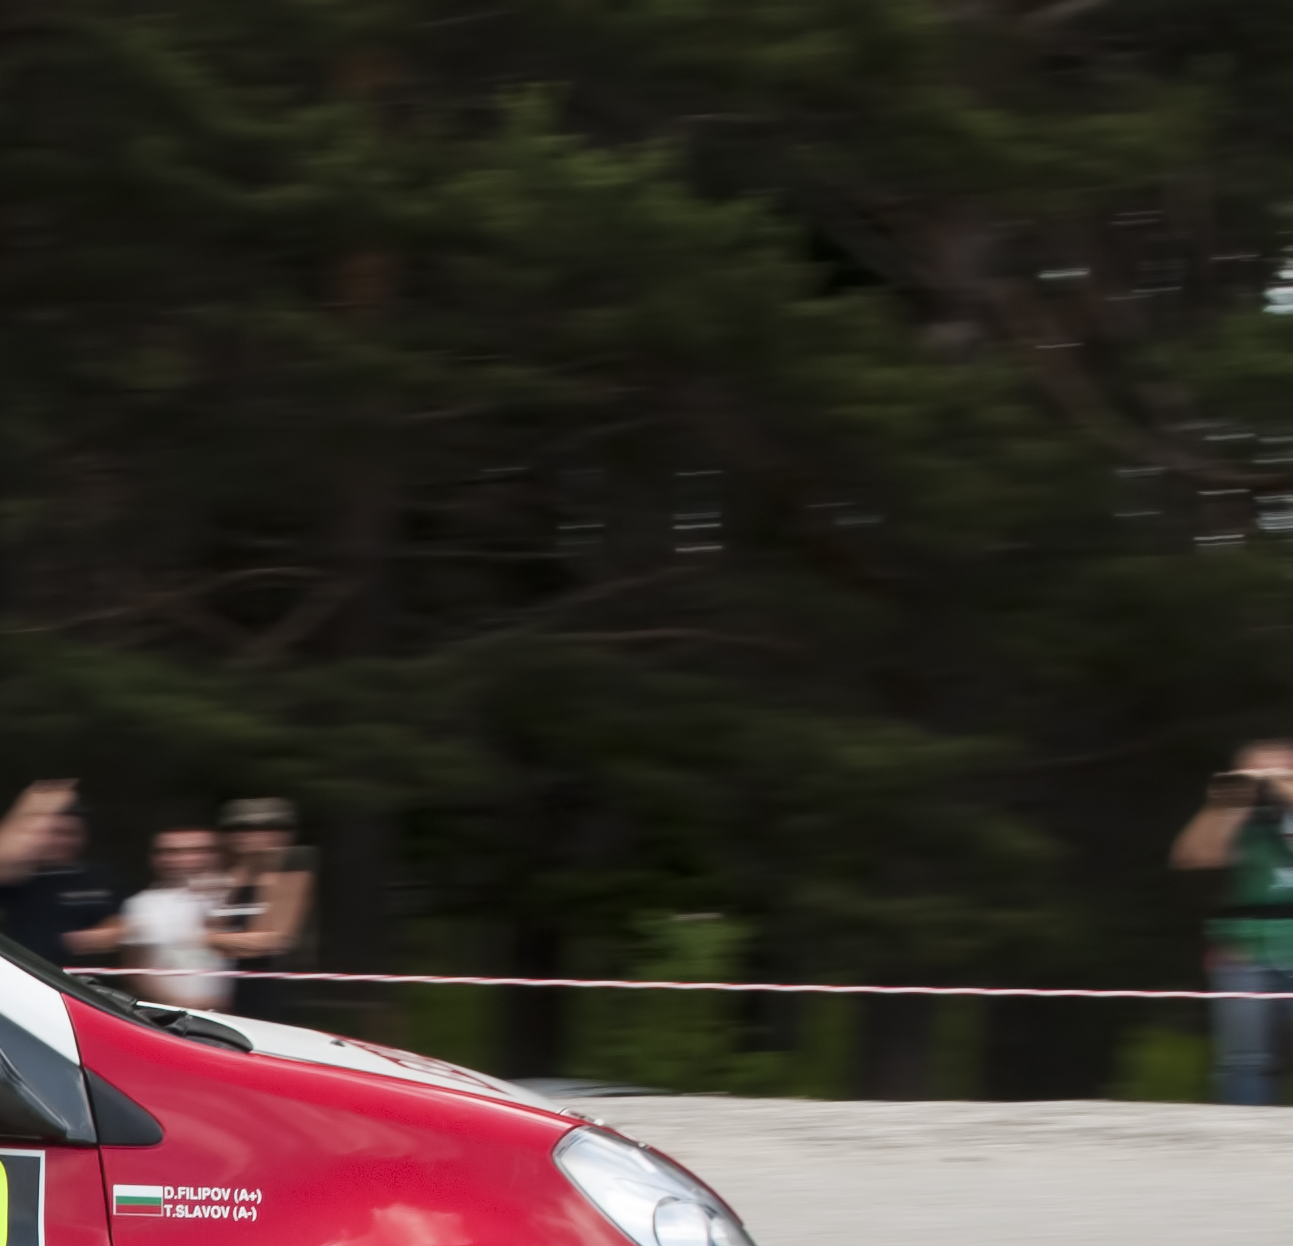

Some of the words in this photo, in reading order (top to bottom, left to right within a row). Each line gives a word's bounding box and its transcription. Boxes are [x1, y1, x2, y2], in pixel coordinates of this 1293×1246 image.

[164, 1186, 231, 1202] D.FILIPOV
[233, 1188, 263, 1205] (A+)
[164, 1204, 231, 1220] T.SLAVOV
[232, 1205, 258, 1222] (A-)
